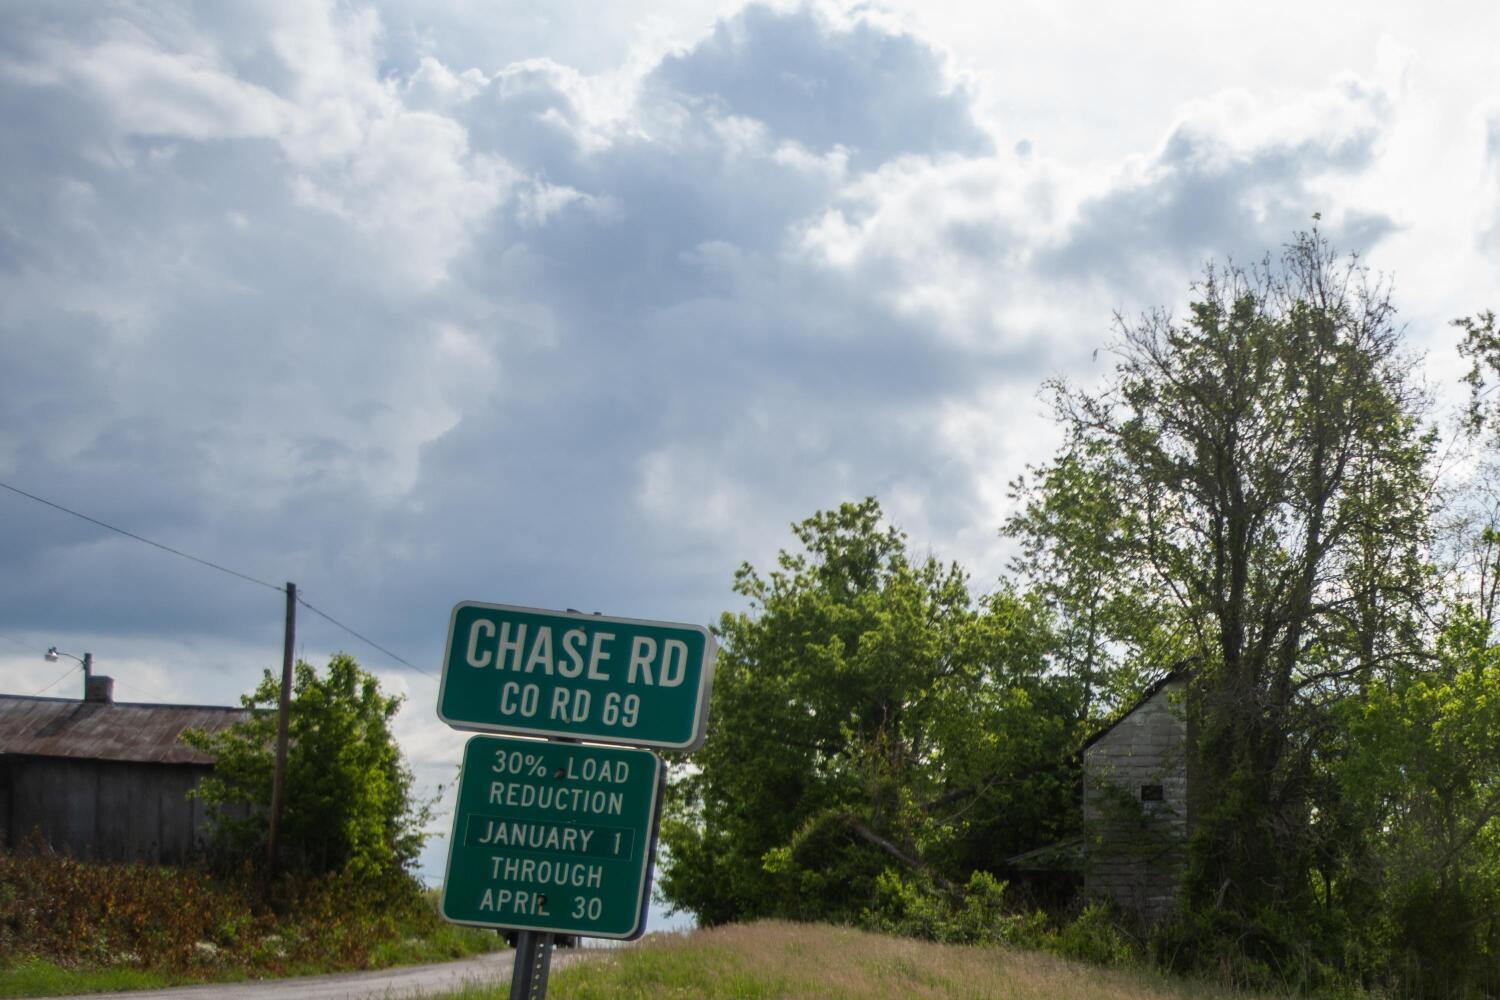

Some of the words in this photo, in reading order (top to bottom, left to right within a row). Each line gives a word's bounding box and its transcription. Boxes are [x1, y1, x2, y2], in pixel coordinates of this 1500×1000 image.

[466, 618, 616, 681] CHASE
[627, 635, 689, 688] RD
[500, 681, 540, 718] CO
[551, 687, 591, 723] RD
[602, 692, 640, 728] 69
[492, 750, 547, 778] 30%
[567, 757, 630, 784] LOAD
[489, 781, 624, 815] REDUCTION
[479, 821, 594, 852] JANUARY
[613, 832, 622, 855] 1
[491, 856, 603, 889] THROUGH
[479, 888, 550, 916] APRIL
[572, 896, 602, 921] 30
